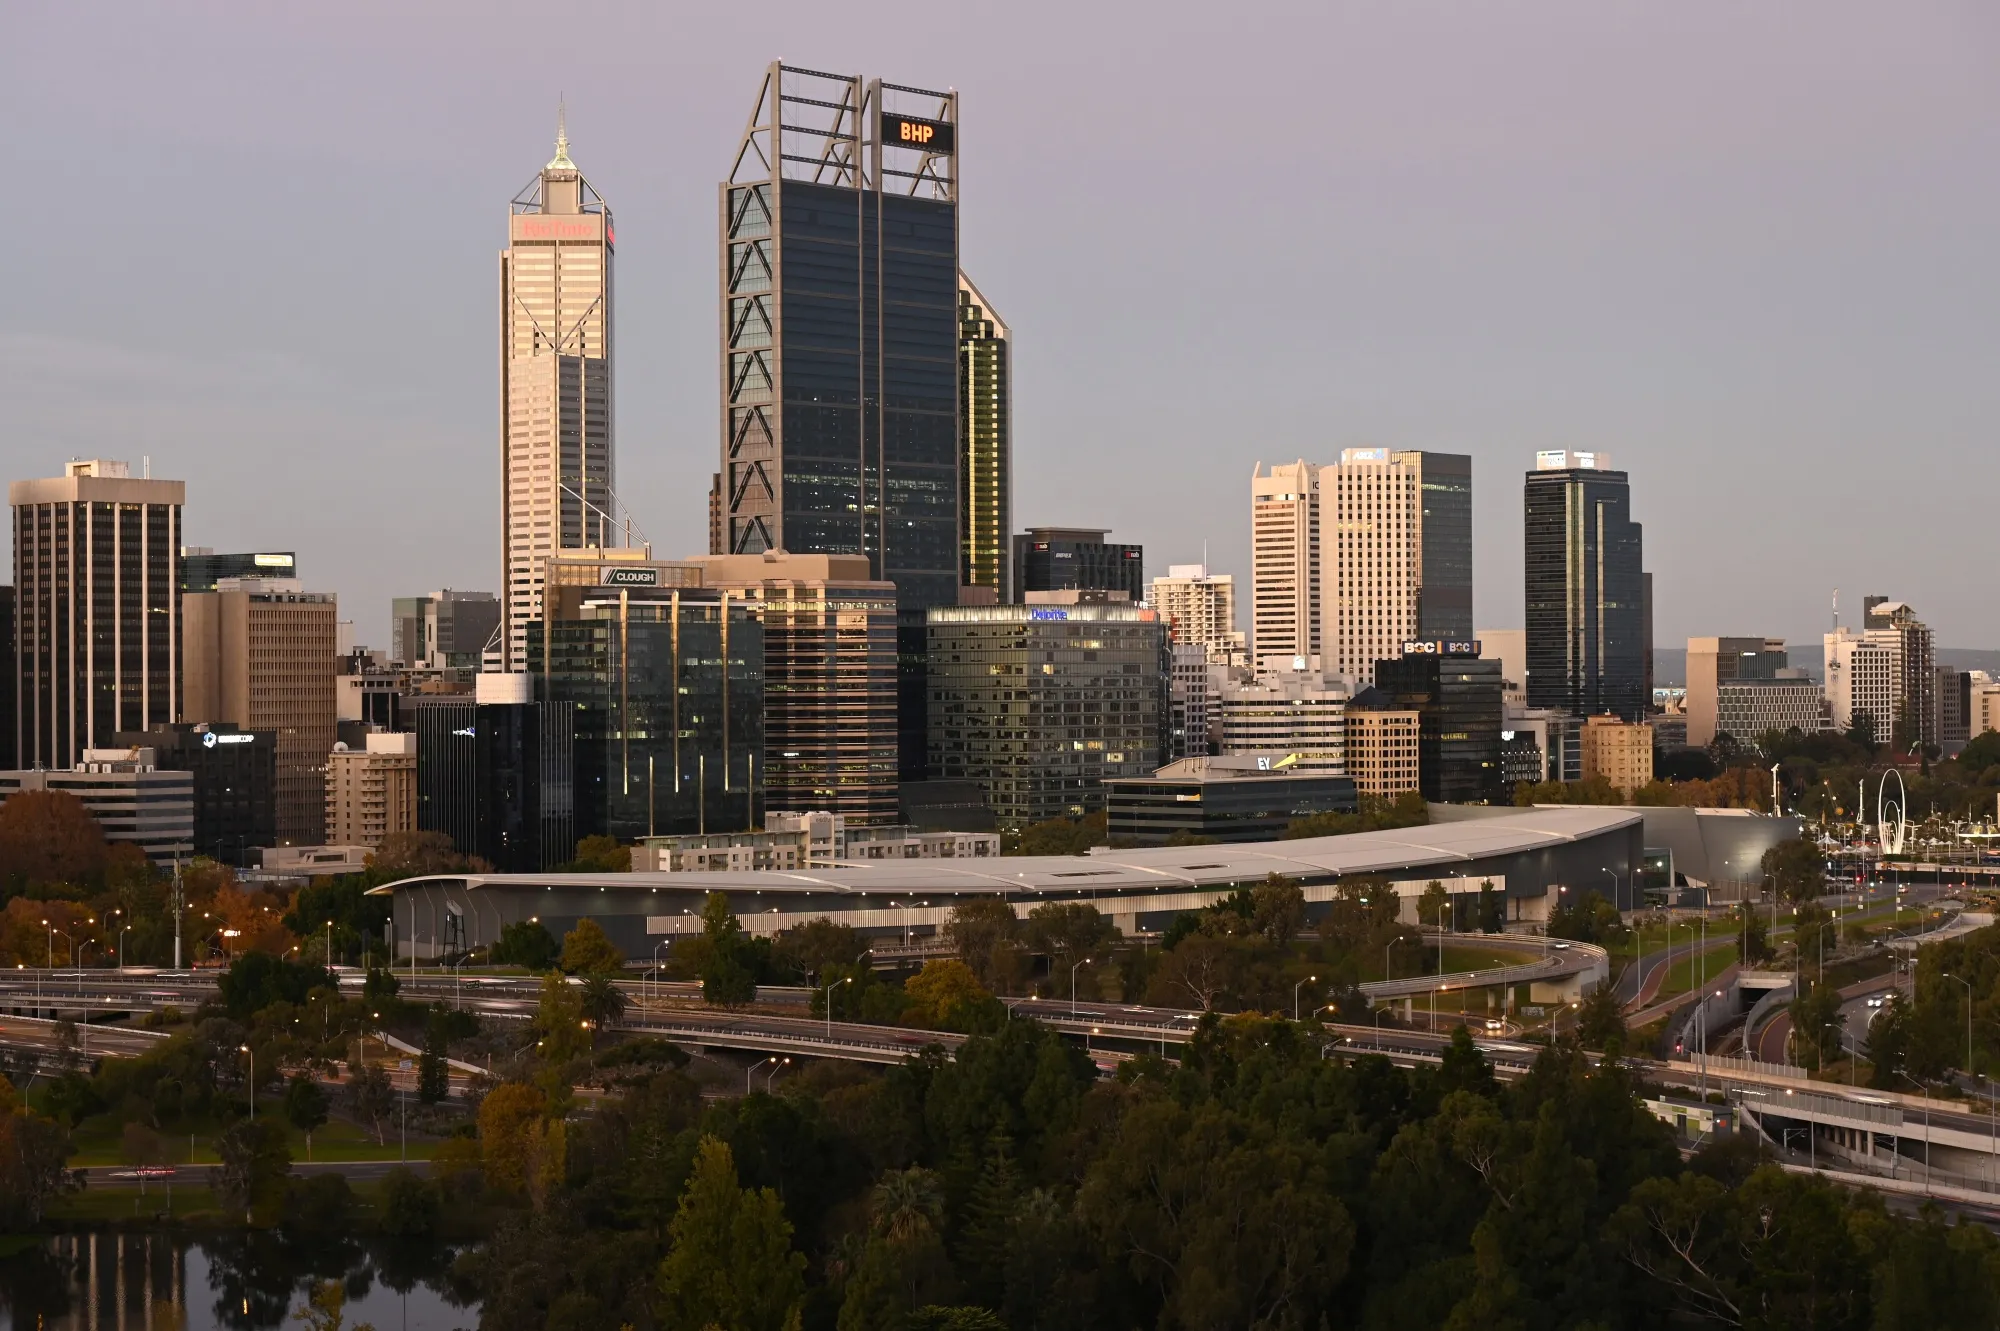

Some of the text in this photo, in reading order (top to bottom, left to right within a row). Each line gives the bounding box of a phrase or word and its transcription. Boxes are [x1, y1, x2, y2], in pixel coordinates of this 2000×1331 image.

[901, 122, 933, 143] BHP
[616, 572, 655, 582] CLOUGH
[1404, 641, 1436, 654] BGC
[1449, 642, 1471, 653] BGC
[1257, 757, 1270, 770] EY
